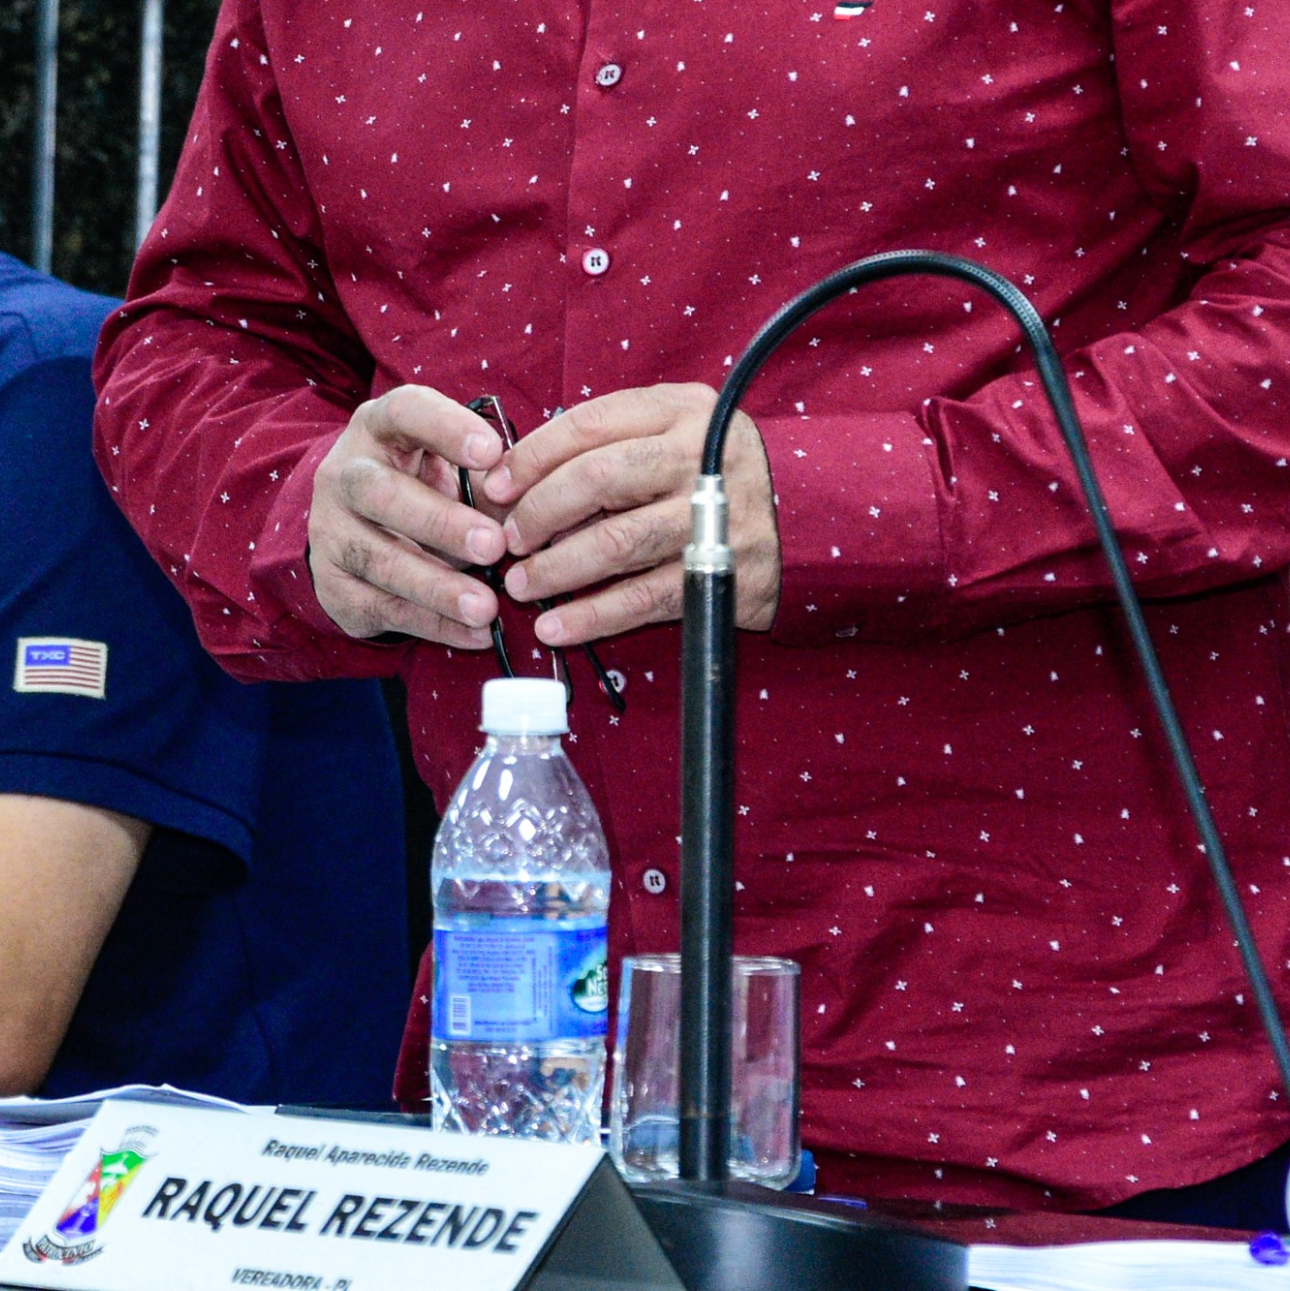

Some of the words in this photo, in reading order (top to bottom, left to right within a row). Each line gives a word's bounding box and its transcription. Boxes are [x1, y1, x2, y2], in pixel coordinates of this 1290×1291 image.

[30, 650, 66, 661] TXC
[260, 1139, 325, 1162] Raquel
[324, 1146, 411, 1171] Aparecida
[414, 1153, 491, 1176] Rezende
[141, 1176, 318, 1232] RAQUEL
[319, 1193, 541, 1254] REZENDE
[231, 1268, 324, 1291] VEREADORA
